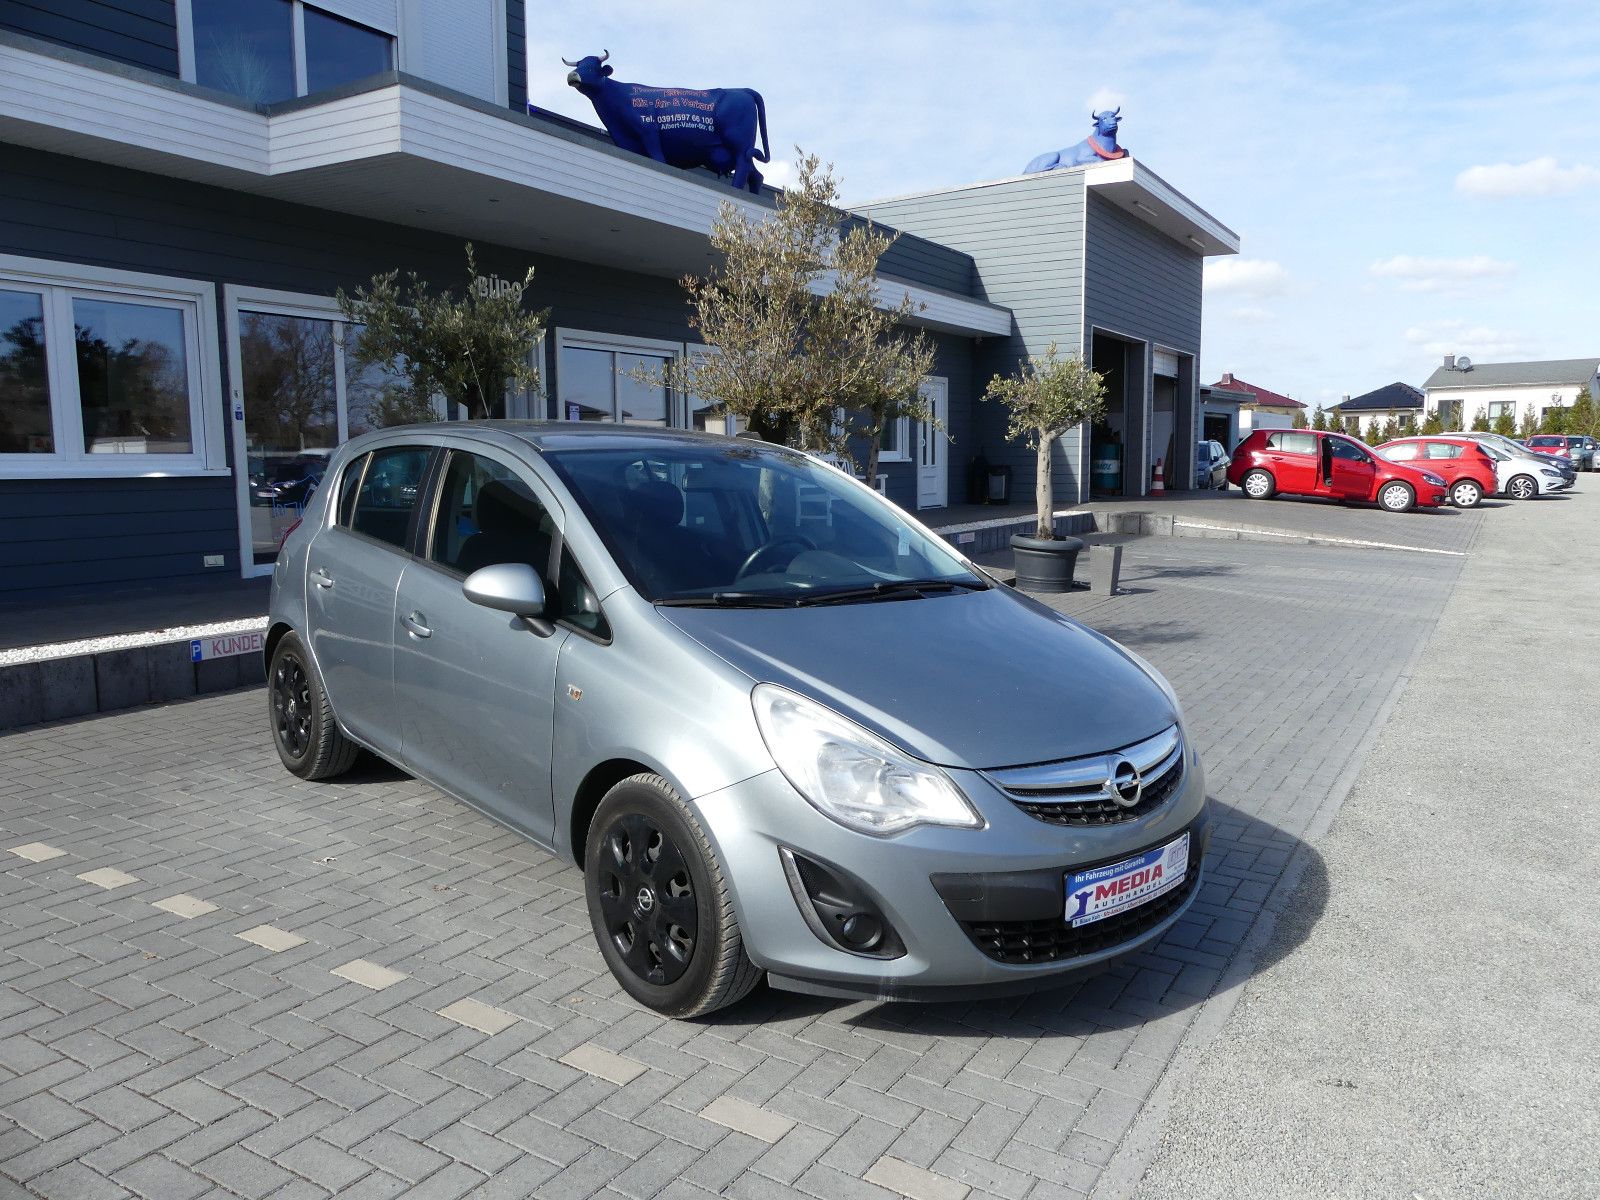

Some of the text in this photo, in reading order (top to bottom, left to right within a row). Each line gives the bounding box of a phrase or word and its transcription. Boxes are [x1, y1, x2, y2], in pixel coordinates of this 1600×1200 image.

[672, 97, 680, 107] &
[682, 97, 715, 111] Verkauf
[640, 115, 655, 123] Tel.
[657, 113, 690, 124] 0391/597
[702, 116, 714, 125] 100
[193, 645, 201, 657] P
[1075, 857, 1145, 884] Ihr Fahrzeug mit Garantie
[1095, 864, 1163, 901] MEDIA
[1094, 881, 1162, 909] AUTOHANDEL
